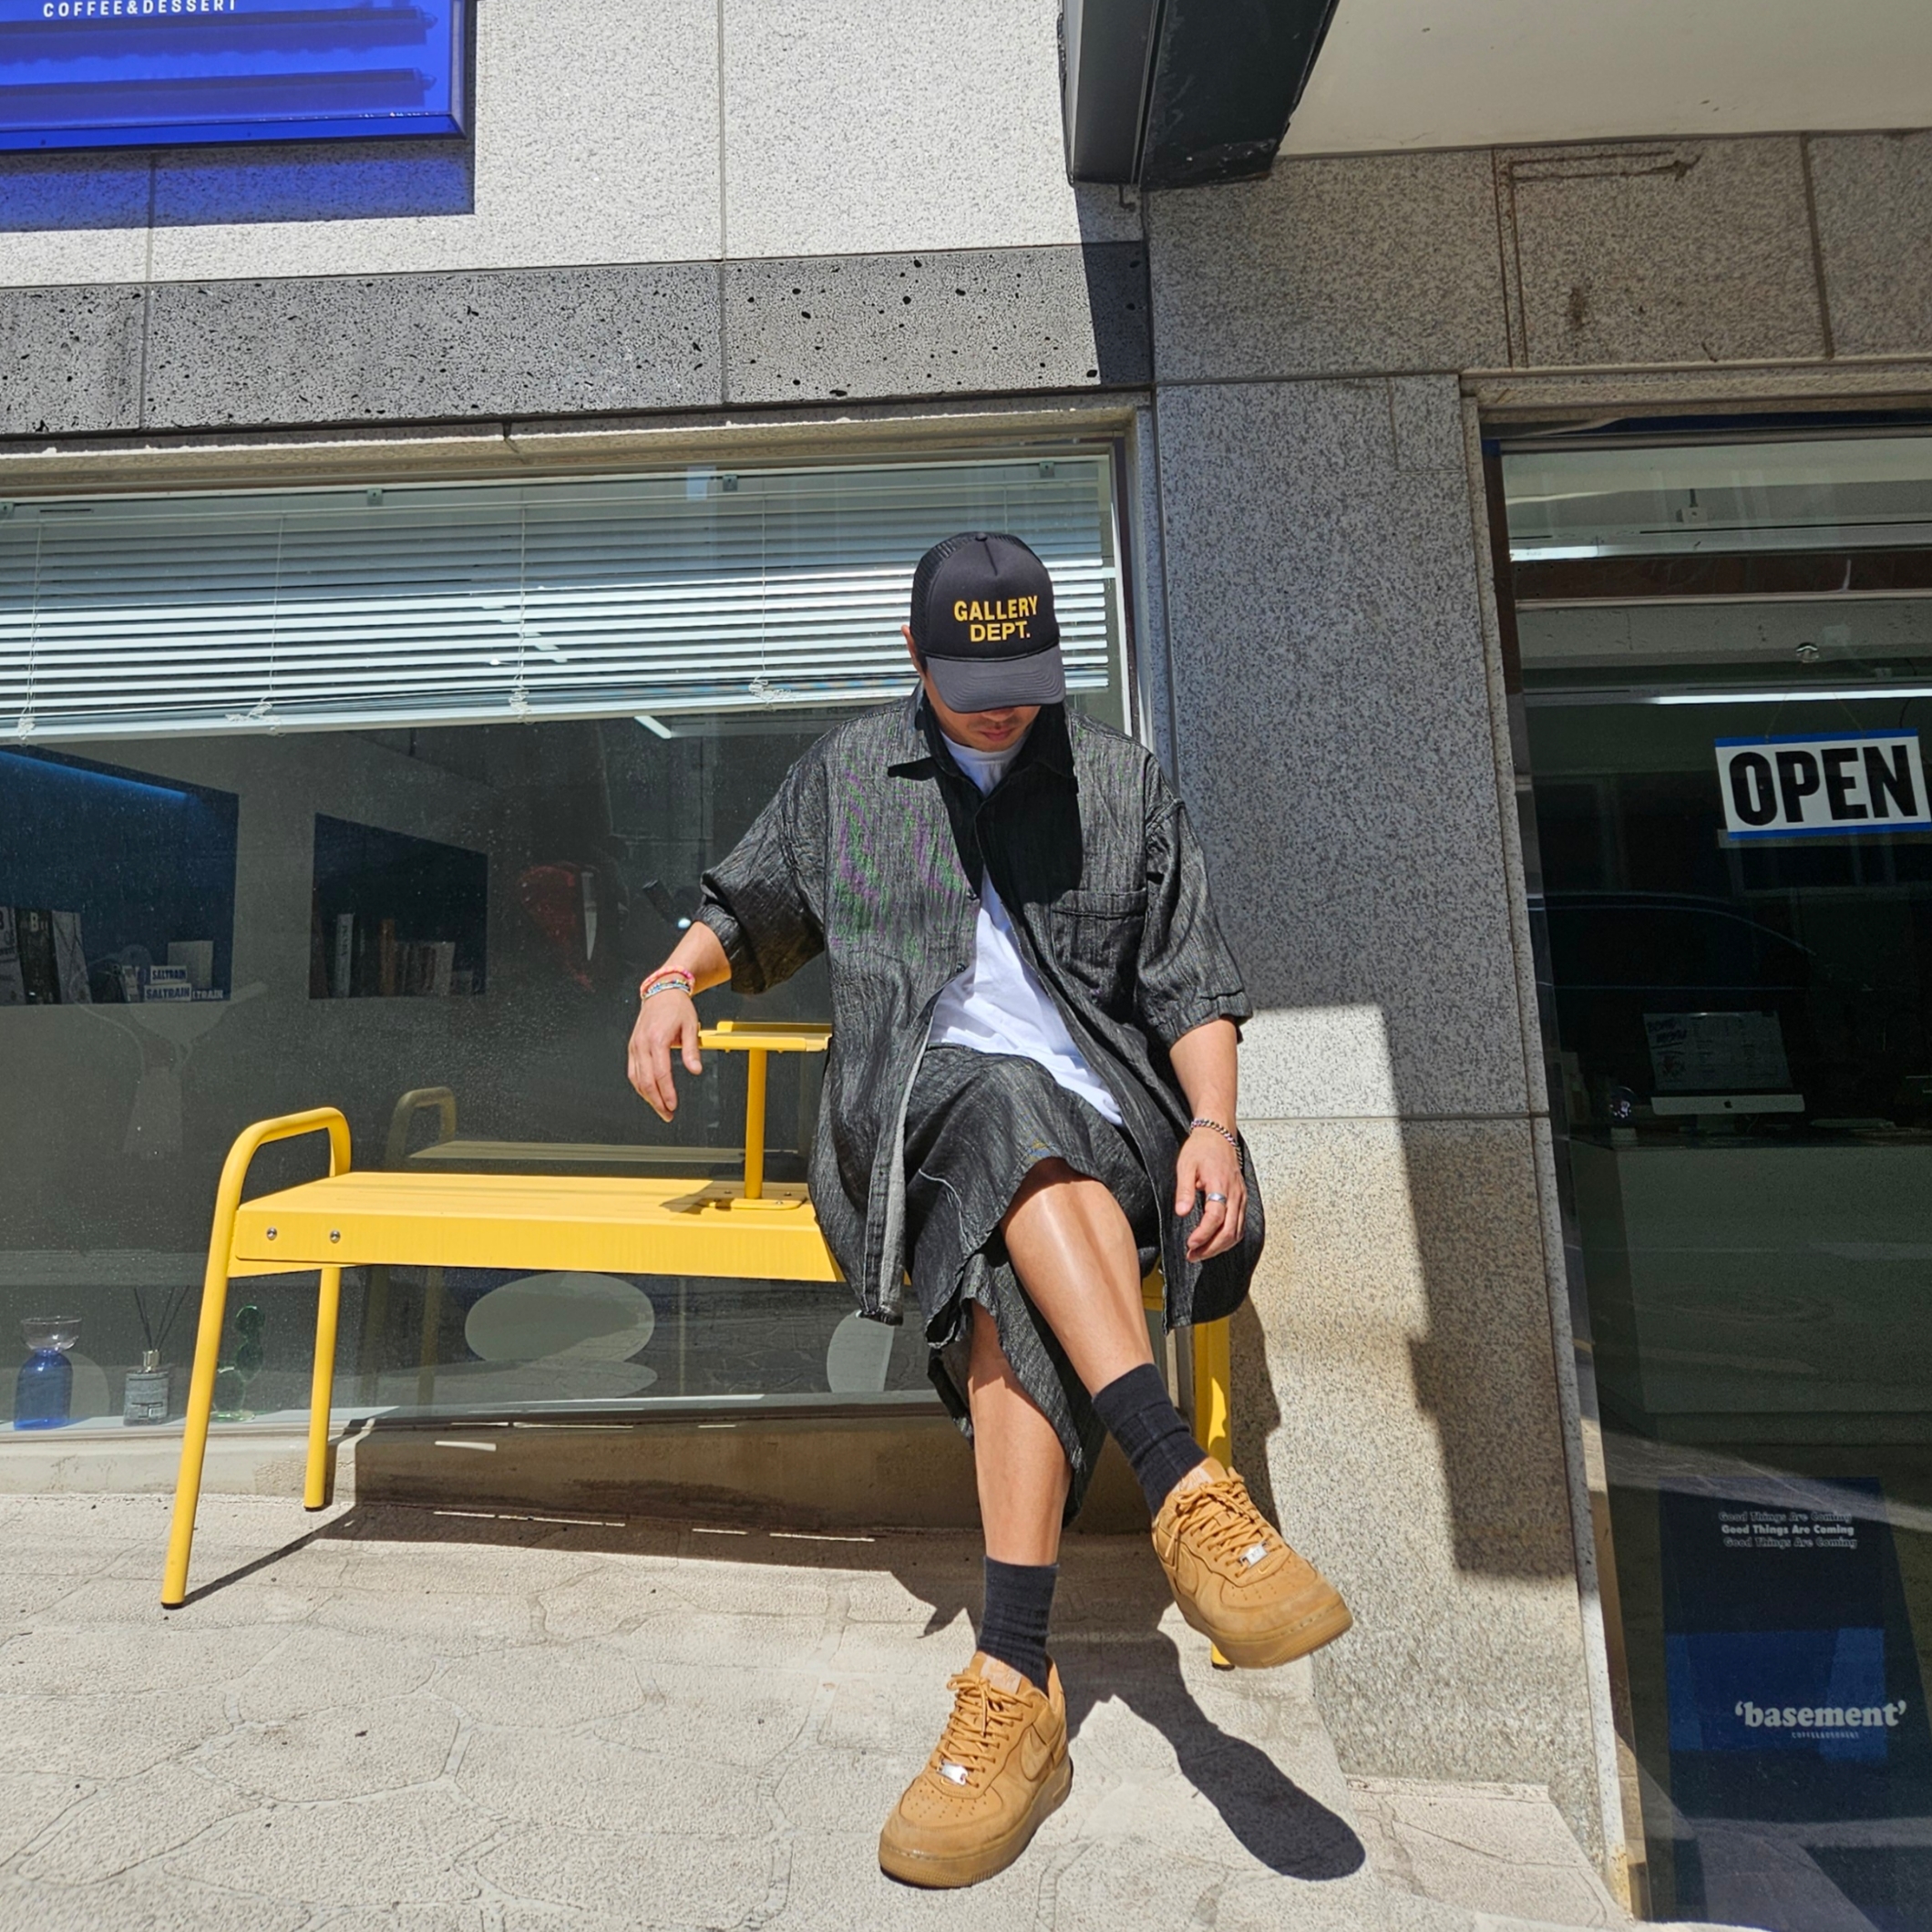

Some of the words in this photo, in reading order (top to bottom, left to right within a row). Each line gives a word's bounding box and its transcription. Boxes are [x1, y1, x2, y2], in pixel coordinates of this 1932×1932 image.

[954, 595, 1038, 622] GALLERY
[970, 621, 1031, 642] DEPT.
[1729, 745, 1918, 827] OPEN
[152, 969, 187, 981] SALTRAIN
[146, 987, 190, 1000] SALTRAIN
[192, 990, 223, 1000] LTRAIN
[1719, 1511, 1747, 1522] Good
[1750, 1511, 1786, 1523] Things
[1721, 1525, 1750, 1535] Good
[1752, 1525, 1789, 1536] Things
[1792, 1525, 1811, 1535] Are
[1814, 1524, 1855, 1536] Coming
[1723, 1536, 1752, 1547] Good
[1754, 1536, 1792, 1549] Things
[1815, 1536, 1857, 1549] Coming
